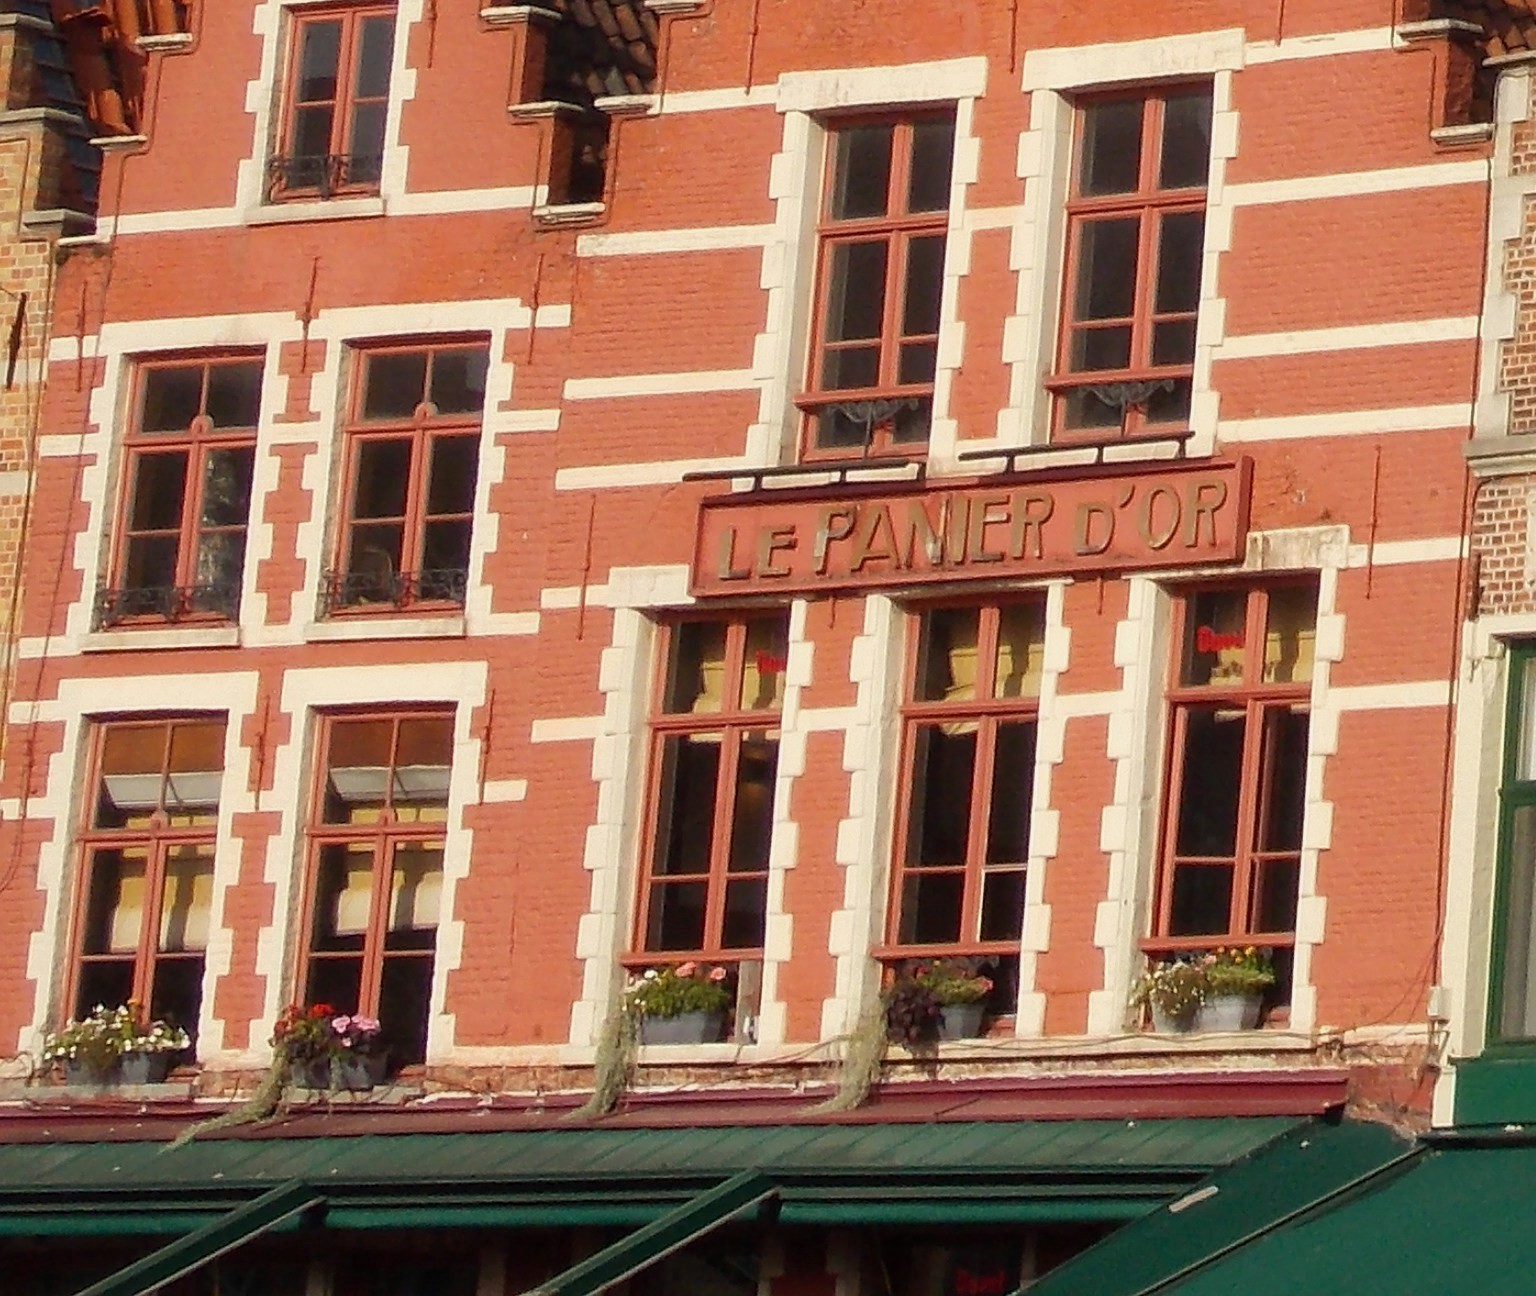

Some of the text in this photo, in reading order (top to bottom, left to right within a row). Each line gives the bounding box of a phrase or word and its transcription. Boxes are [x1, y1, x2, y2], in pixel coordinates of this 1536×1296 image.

[718, 476, 1228, 580] LE PANIER D'OR
